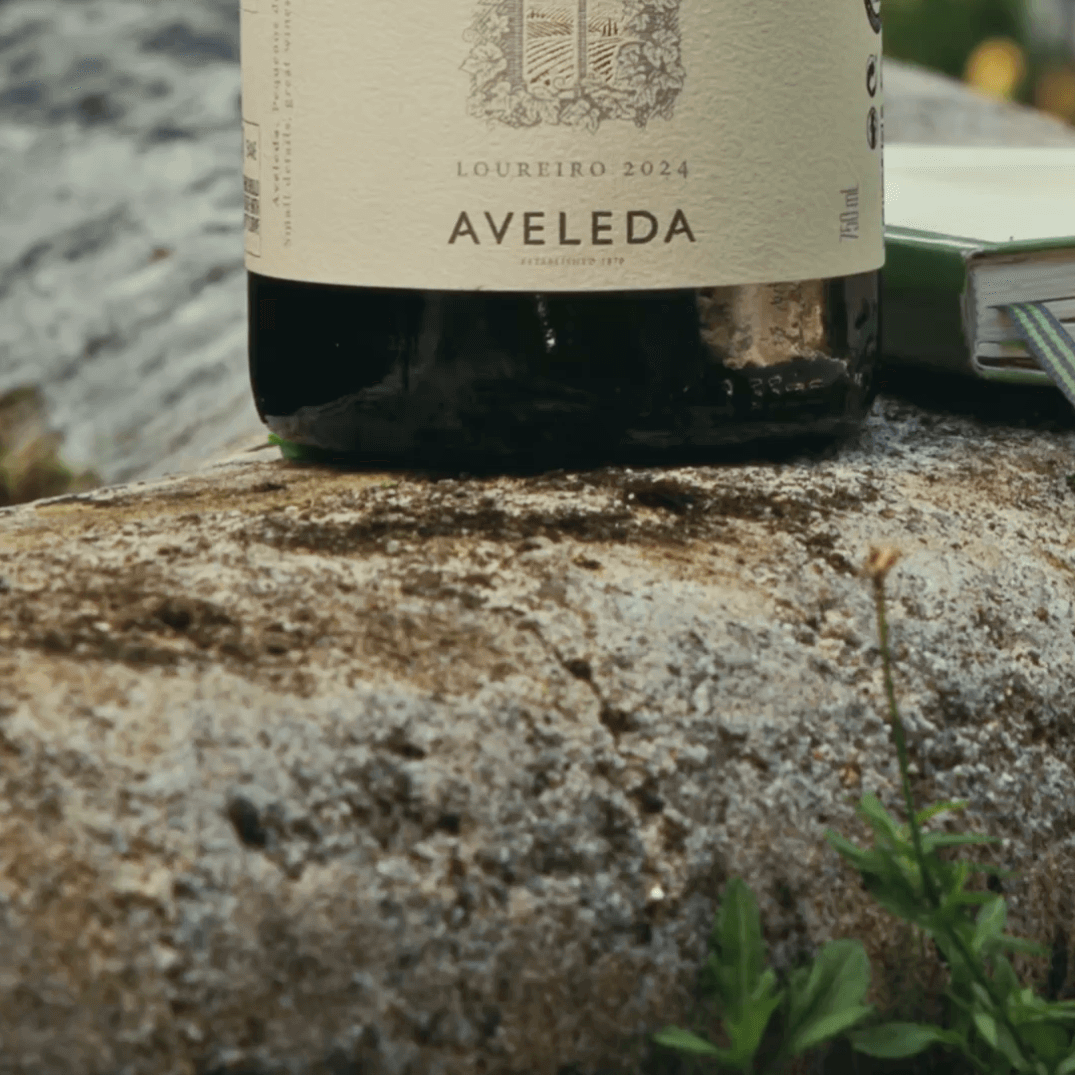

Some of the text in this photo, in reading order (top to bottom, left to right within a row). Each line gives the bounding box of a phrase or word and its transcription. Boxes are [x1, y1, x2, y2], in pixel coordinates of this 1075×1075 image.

[271, 22, 281, 112] Pequenos
[456, 159, 690, 179] LOUREIRO 2024
[447, 208, 697, 246] AVELEDA
[839, 211, 859, 243] 750
